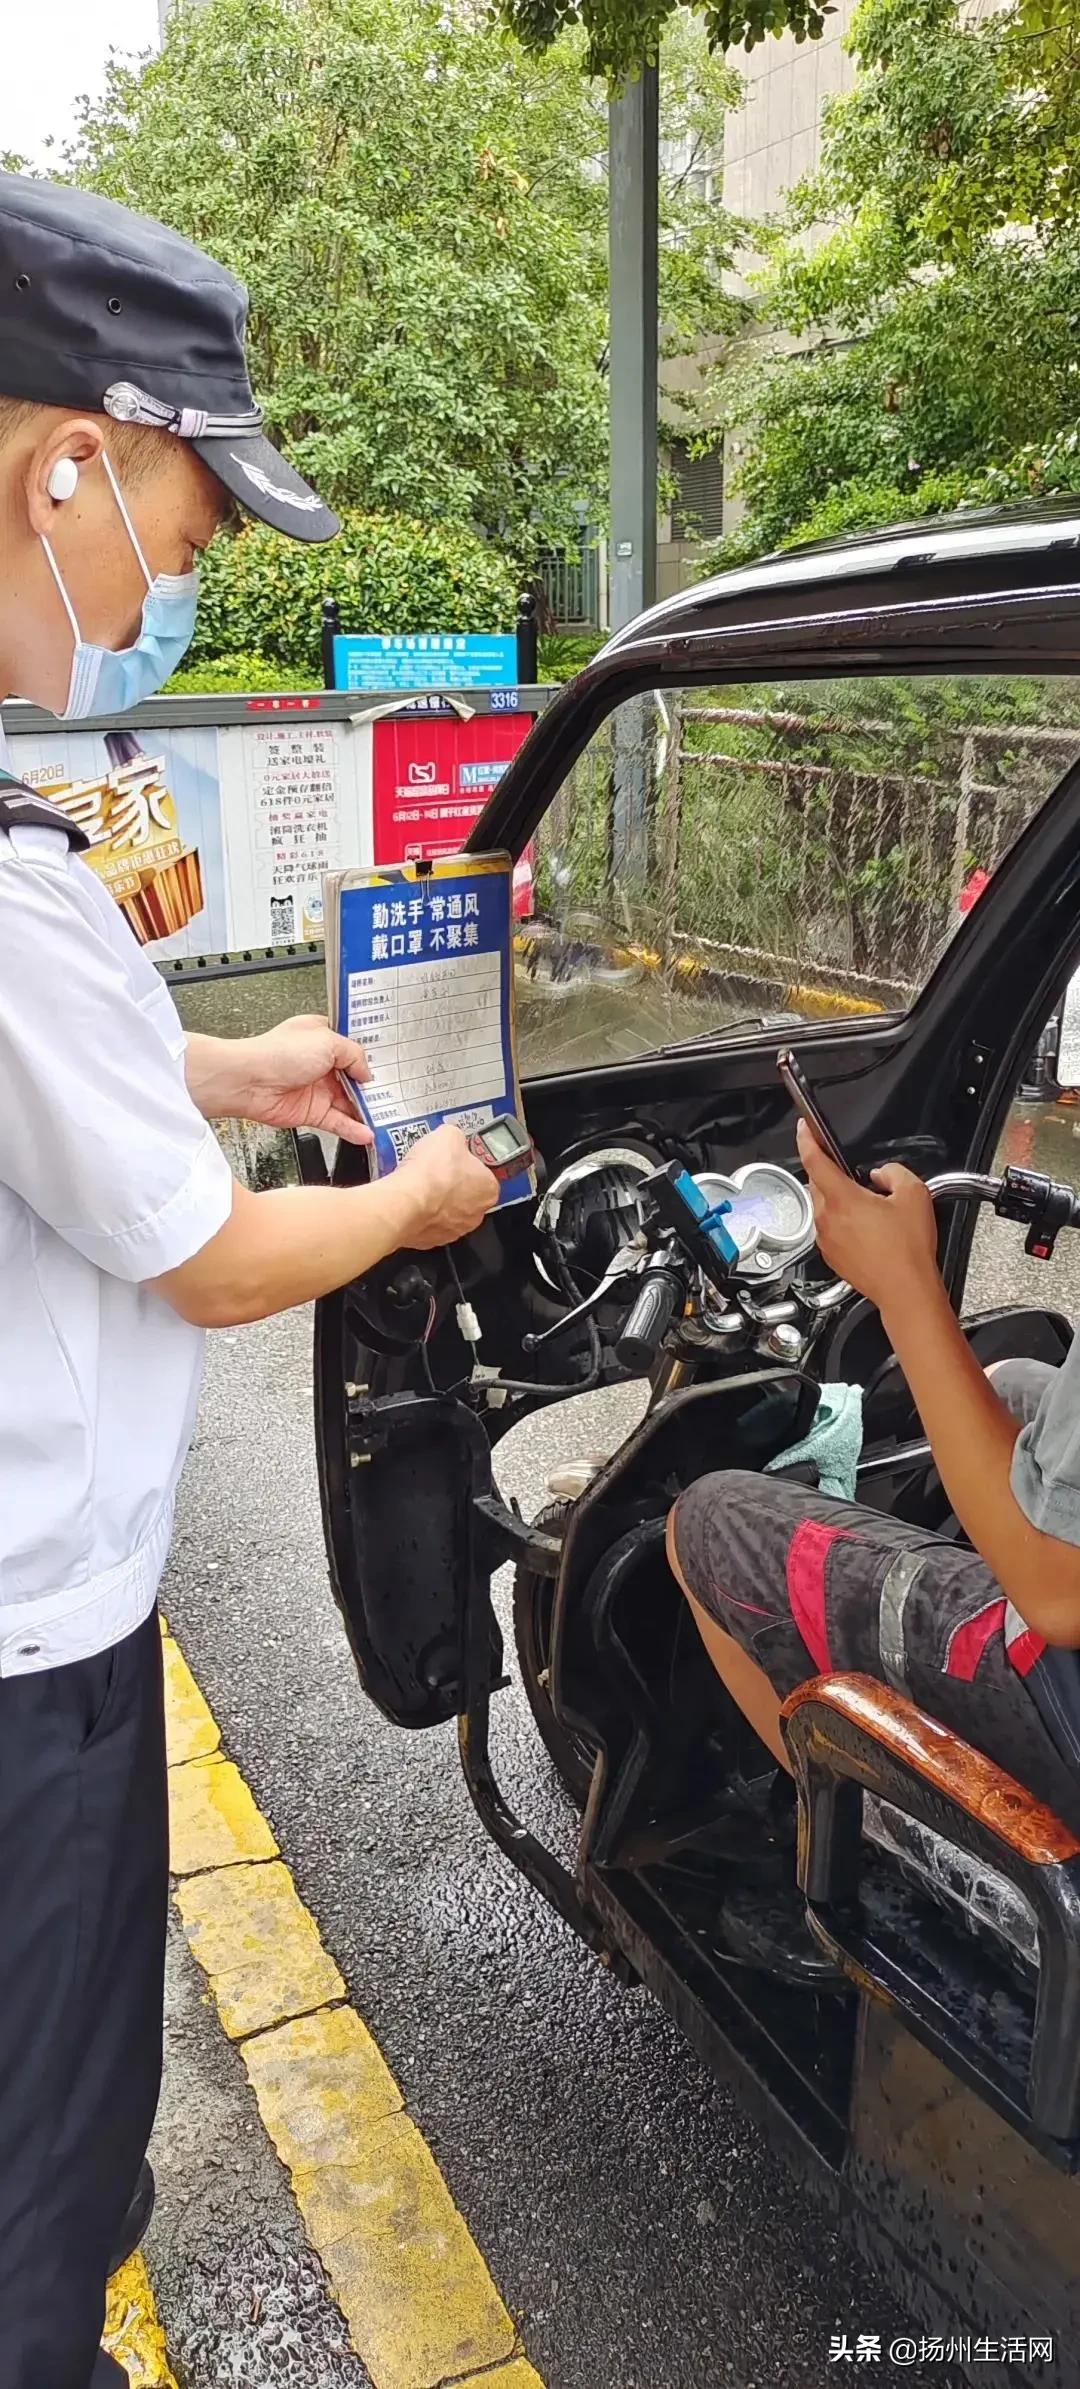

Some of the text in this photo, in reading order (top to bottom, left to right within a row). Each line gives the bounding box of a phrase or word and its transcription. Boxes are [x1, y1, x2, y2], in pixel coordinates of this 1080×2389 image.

[491, 692, 518, 708] 3316
[372, 893, 480, 929] 勤洗手 常通风
[371, 921, 480, 961] 戴口罩 不聚集
